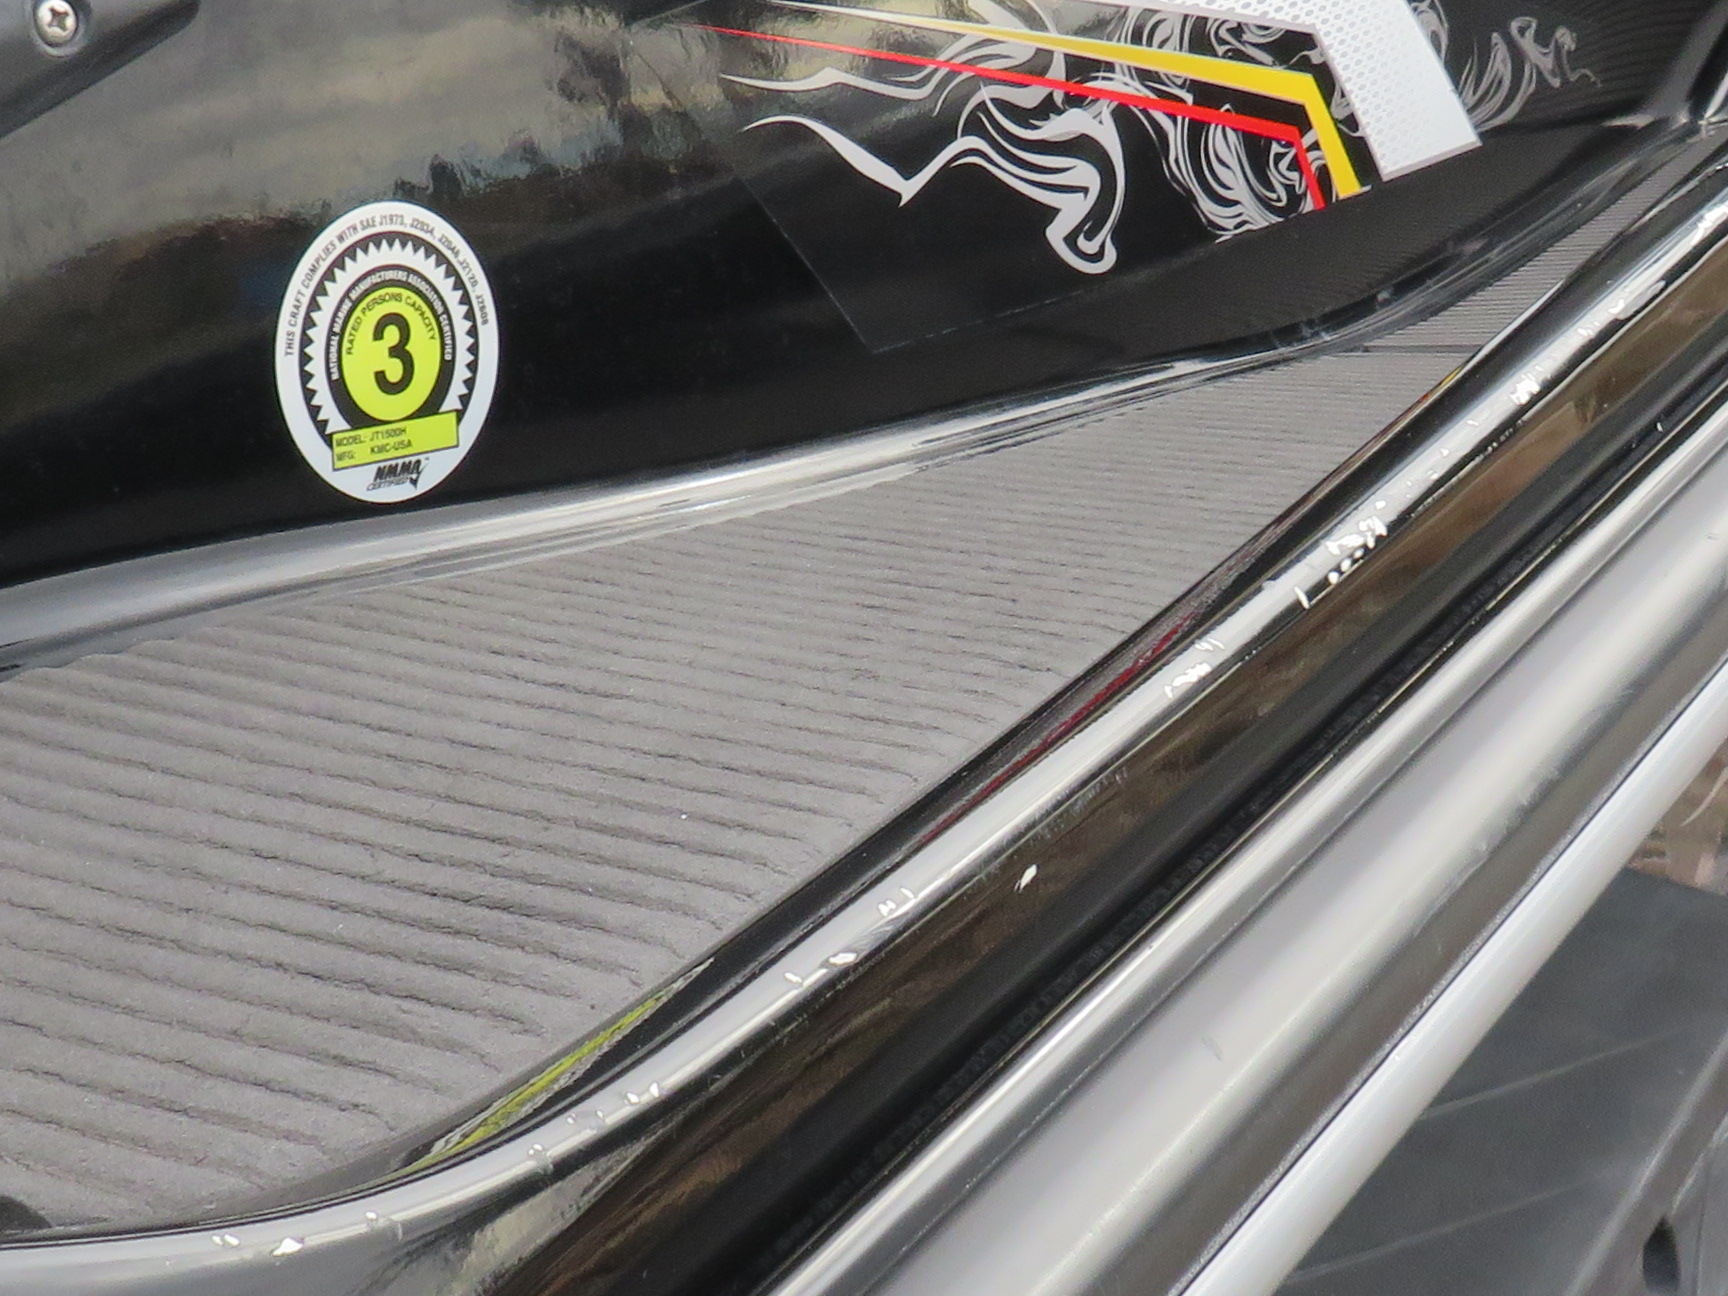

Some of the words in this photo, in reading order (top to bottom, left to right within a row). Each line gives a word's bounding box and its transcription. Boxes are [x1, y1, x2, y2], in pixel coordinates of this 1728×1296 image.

[336, 224, 359, 245] WITH
[359, 215, 377, 232] SAE
[302, 242, 337, 288] COMPLIES
[288, 290, 306, 326] CRAFT
[345, 316, 363, 355] RATED
[361, 292, 403, 317] PERSONS
[405, 295, 437, 341] CAPACITY
[284, 328, 295, 357] THIS
[329, 335, 340, 380] NATIONAL
[372, 311, 415, 396] 3
